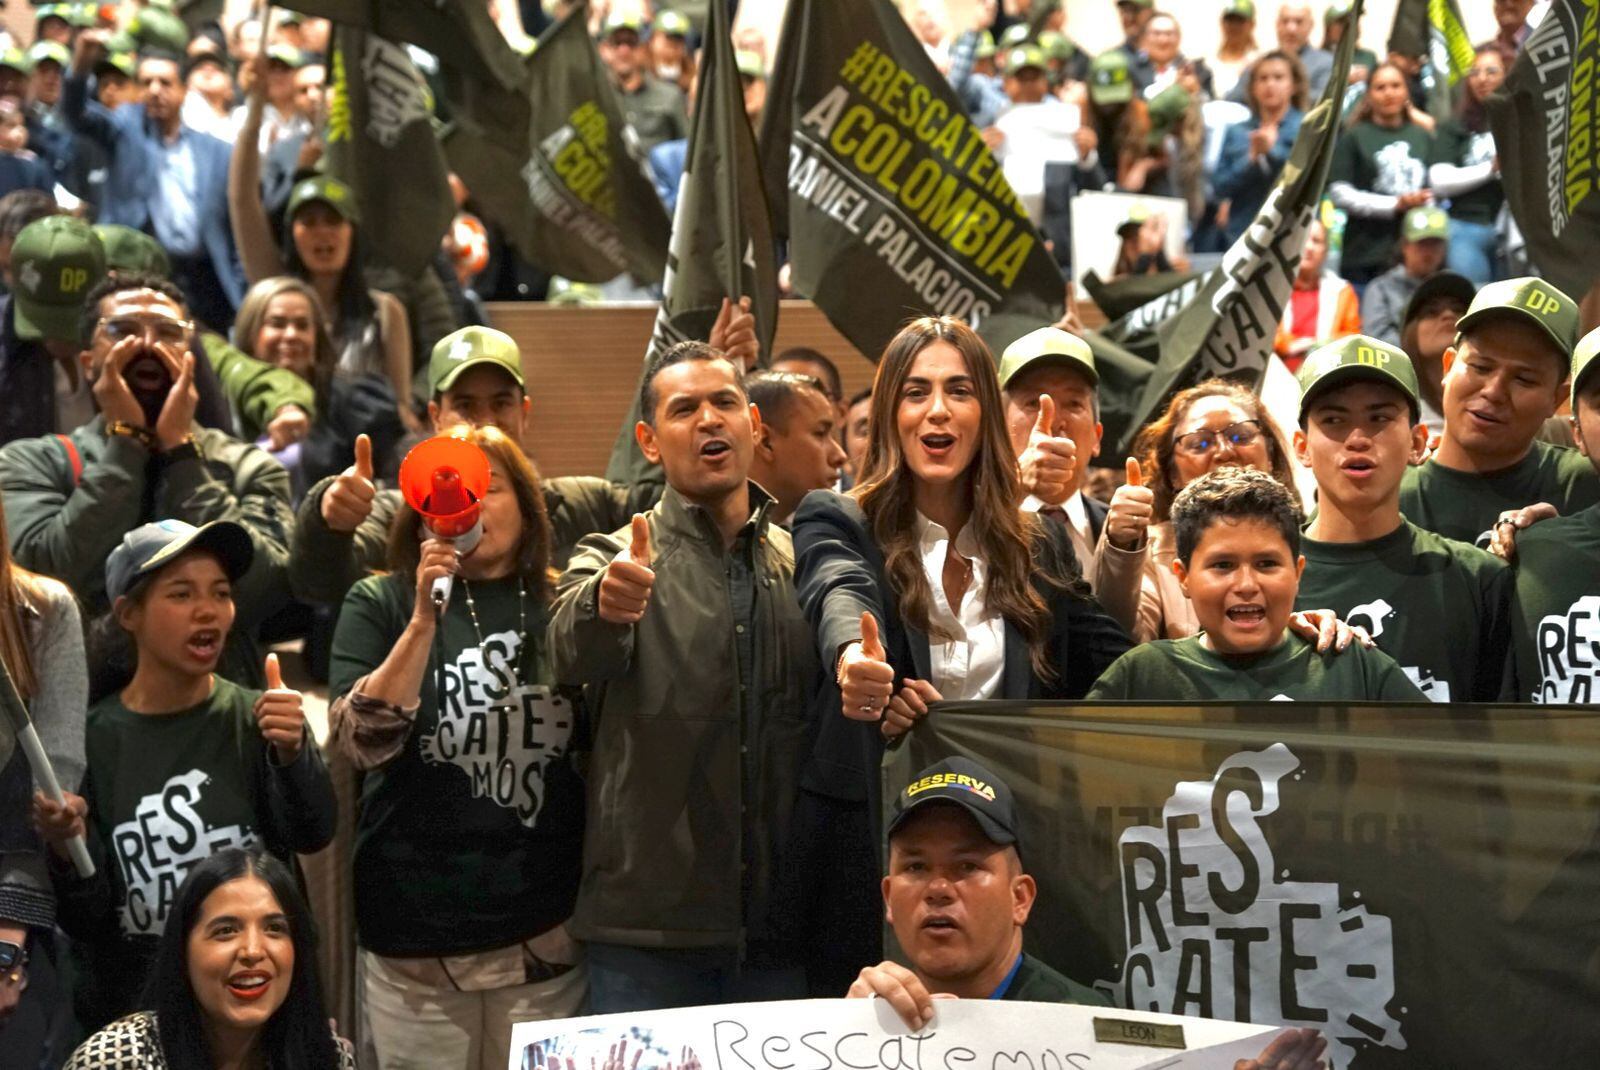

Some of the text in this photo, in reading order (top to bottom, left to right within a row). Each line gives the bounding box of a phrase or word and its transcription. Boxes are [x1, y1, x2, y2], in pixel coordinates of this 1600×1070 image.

[840, 41, 1030, 219] #RESCATEM
[1543, 81, 1567, 238] PALACIOS
[60, 267, 88, 292] DP
[864, 212, 991, 331] PALACIOS
[1525, 289, 1560, 316] DP
[1358, 346, 1390, 368] DP
[438, 640, 511, 719] RES
[437, 693, 545, 768] CATE
[472, 758, 542, 820] MOS
[907, 773, 996, 799] RESERVA
[115, 784, 197, 885] RES
[1122, 766, 1264, 952] RES
[1125, 903, 1328, 1024] CATE
[1120, 1024, 1157, 1041] LEON
